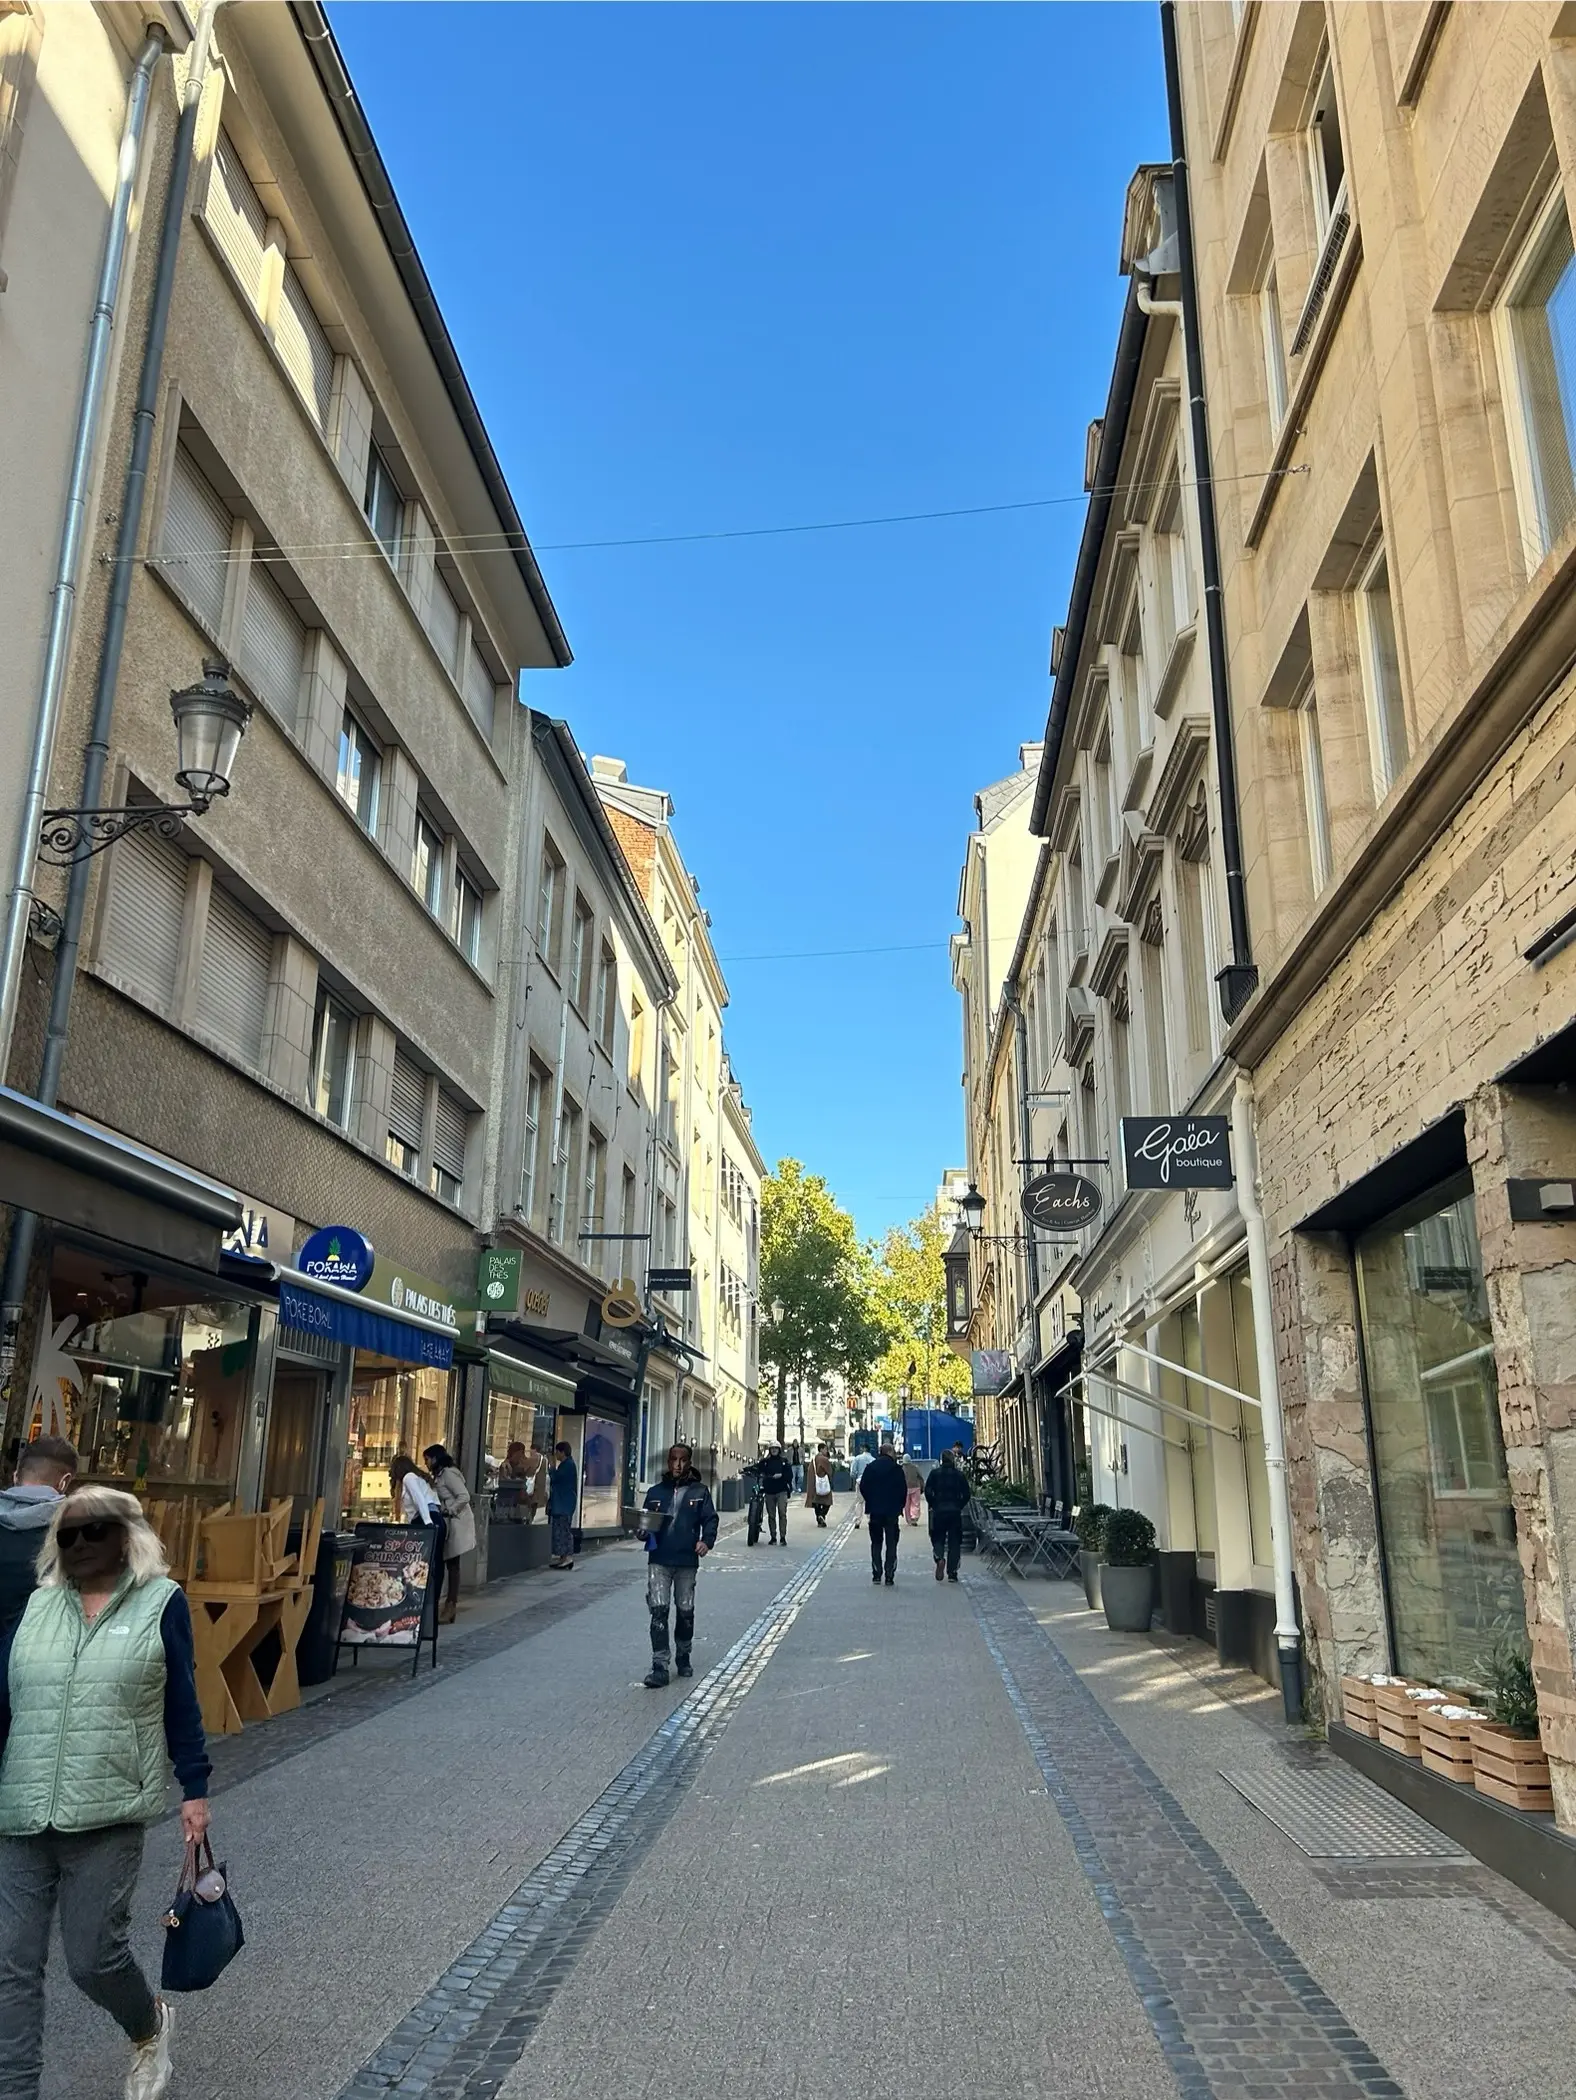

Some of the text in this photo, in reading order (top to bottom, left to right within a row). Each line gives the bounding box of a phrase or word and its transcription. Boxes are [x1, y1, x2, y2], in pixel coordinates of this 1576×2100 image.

[1176, 1158, 1223, 1168] boutique
[1026, 1179, 1090, 1215] Eachs
[306, 1260, 358, 1274] POKAWA
[489, 1256, 517, 1266] PALAIS
[489, 1264, 505, 1272] DES
[405, 1288, 428, 1316] PALAIS
[427, 1298, 441, 1320] DES
